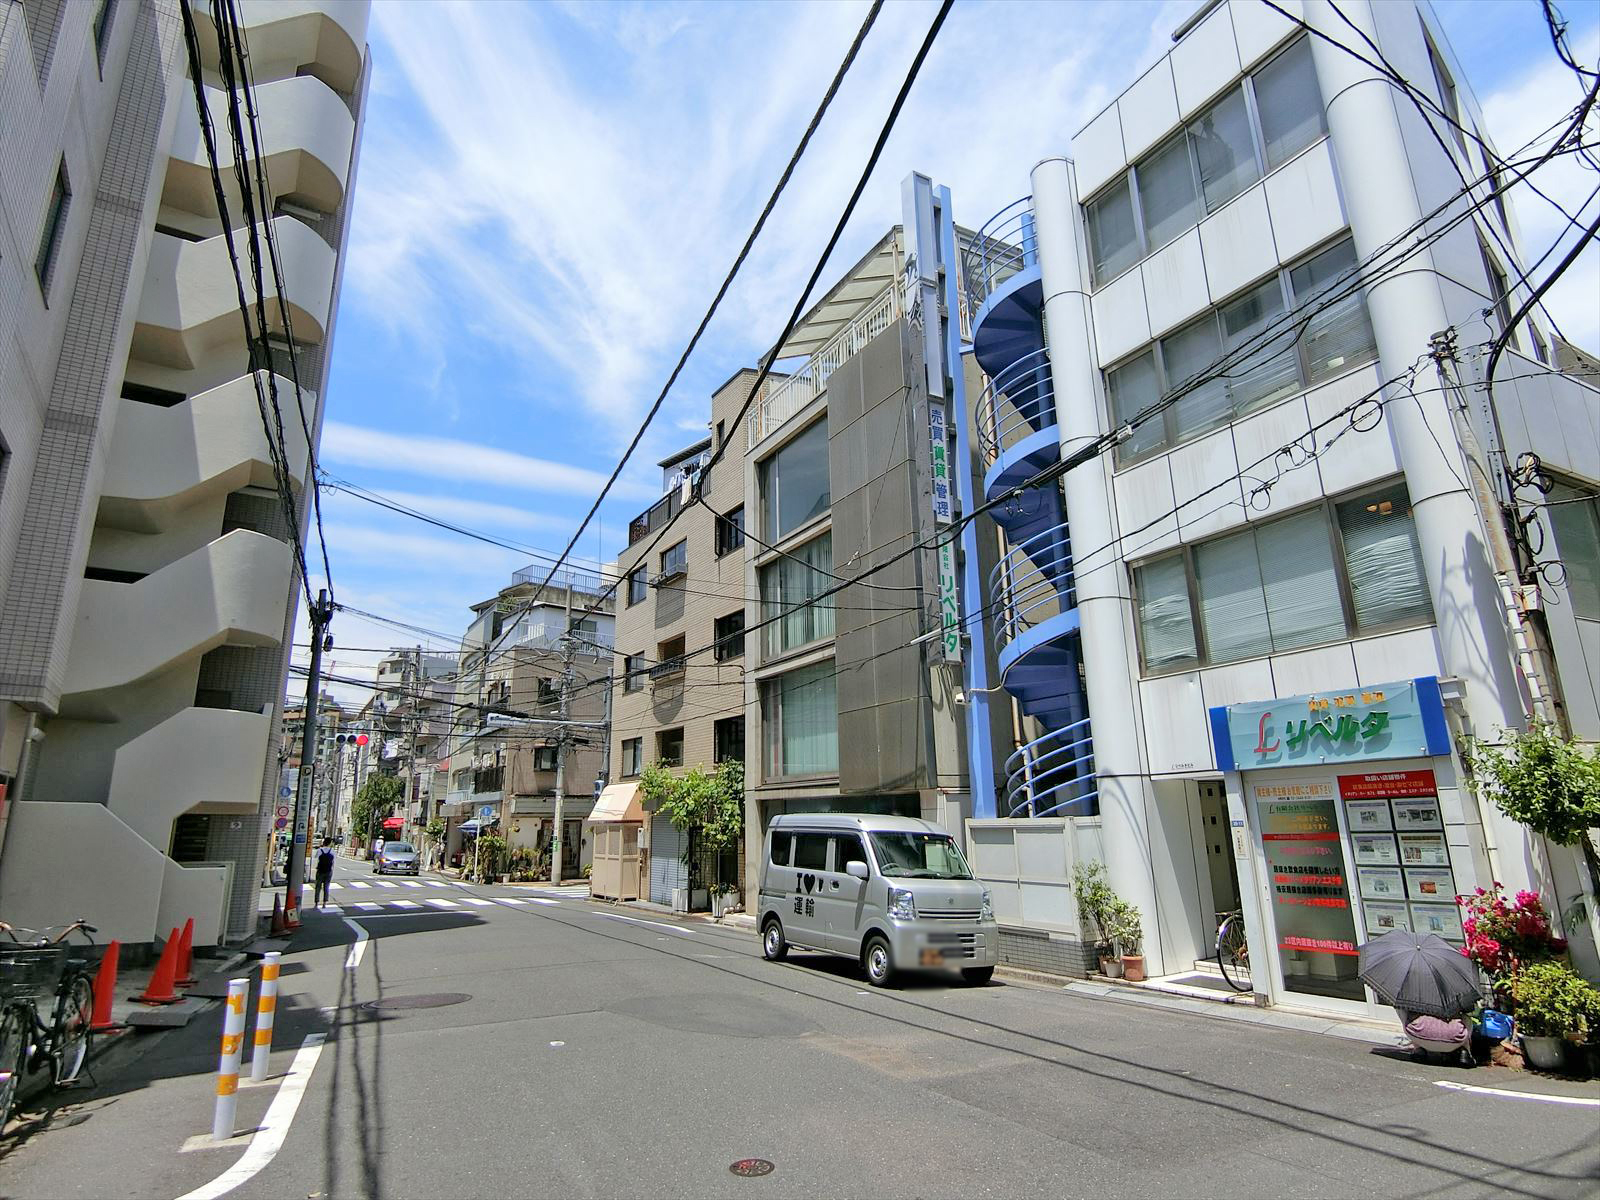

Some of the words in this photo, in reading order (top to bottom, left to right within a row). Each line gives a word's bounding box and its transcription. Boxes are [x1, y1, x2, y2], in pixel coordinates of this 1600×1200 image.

[940, 574, 957, 653] リベルタ
[1286, 710, 1390, 747] リベルタ
